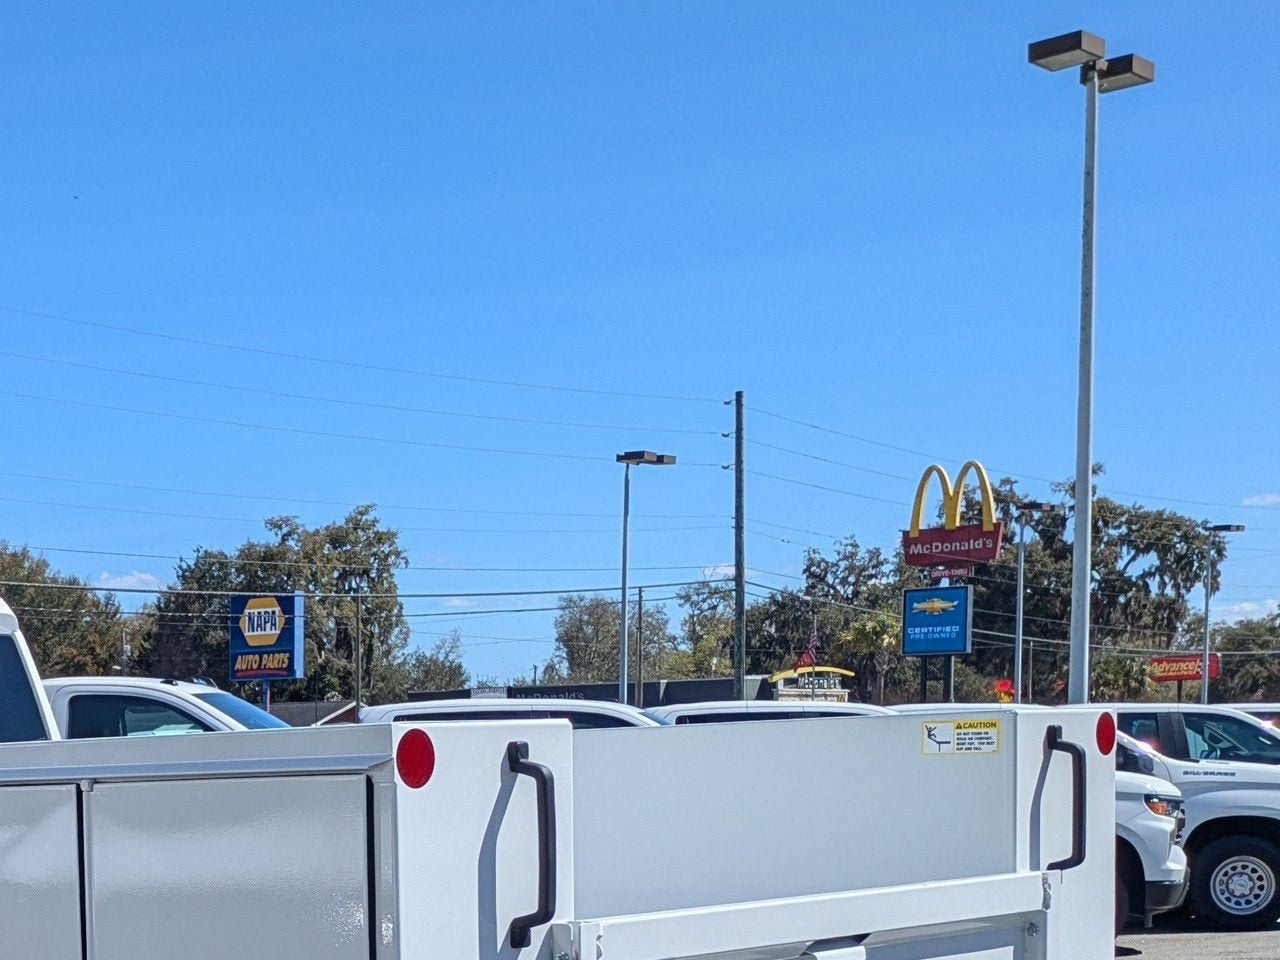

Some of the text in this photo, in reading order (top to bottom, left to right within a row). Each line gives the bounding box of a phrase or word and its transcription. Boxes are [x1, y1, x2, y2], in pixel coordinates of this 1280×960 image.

[909, 538, 993, 554] McDonald's
[931, 568, 968, 577] DRIVE-THRU
[247, 610, 277, 633] NAPA
[907, 625, 960, 634] CERTIFIED
[234, 653, 290, 670] AUTO PARTS
[1150, 661, 1195, 671] Advance
[962, 721, 997, 729] CAUTION
